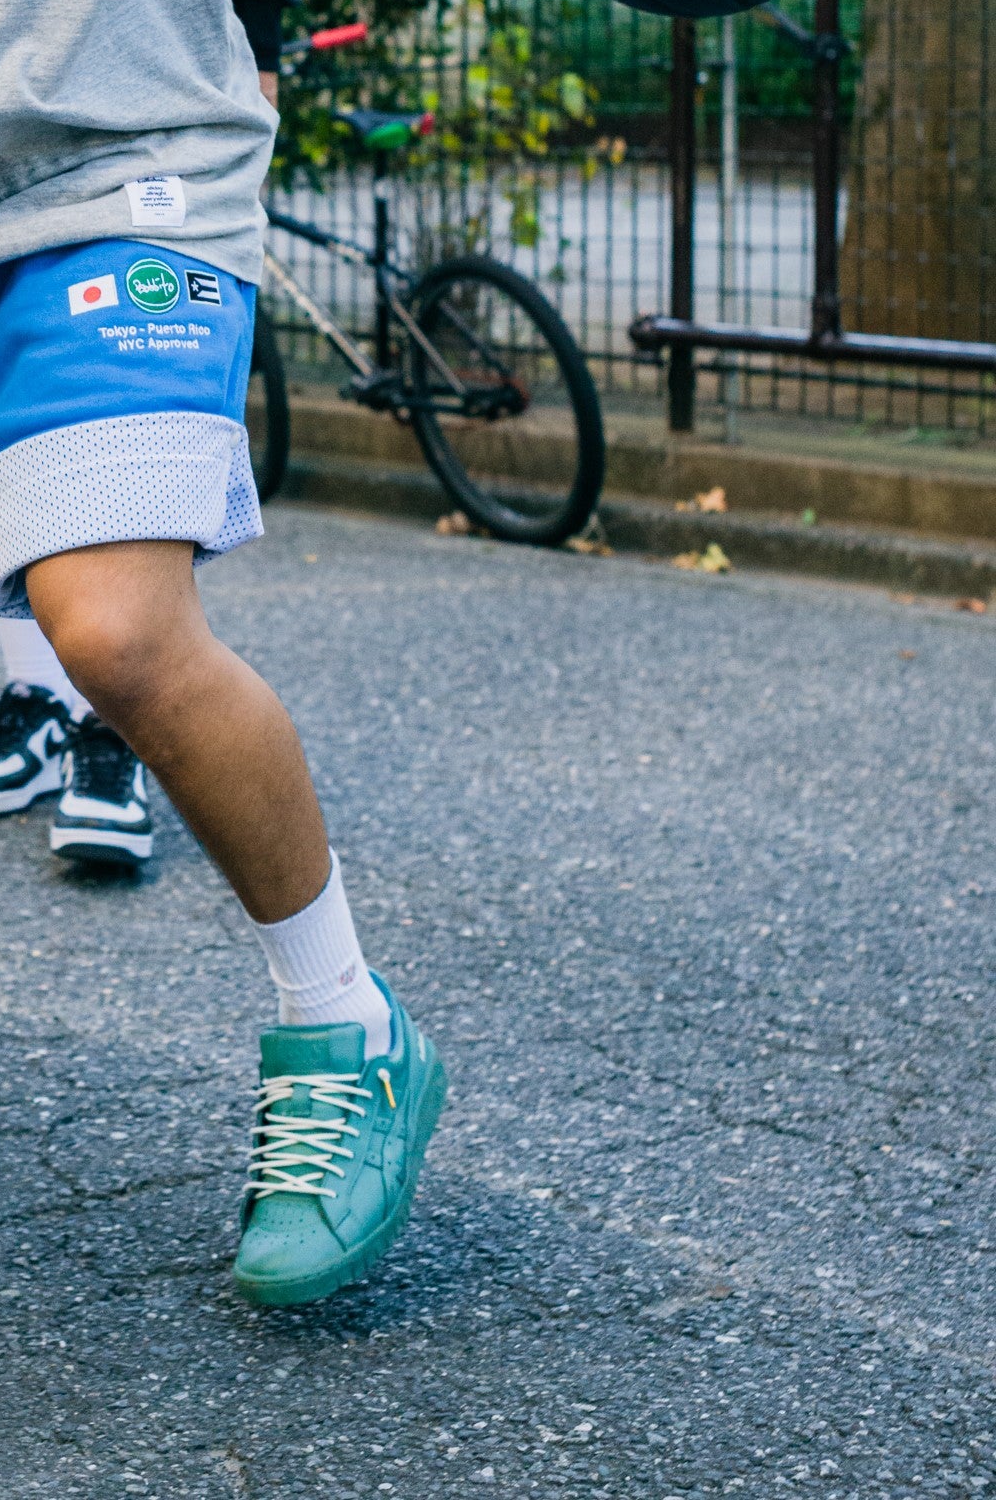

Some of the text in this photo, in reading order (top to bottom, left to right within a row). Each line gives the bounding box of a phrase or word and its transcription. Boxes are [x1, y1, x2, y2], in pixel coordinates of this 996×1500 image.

[132, 273, 174, 296] Bobbito
[97, 325, 137, 338] Tokyo
[147, 323, 186, 335] Puerto
[188, 323, 211, 336] Rico
[118, 337, 200, 351] NYC Approved
